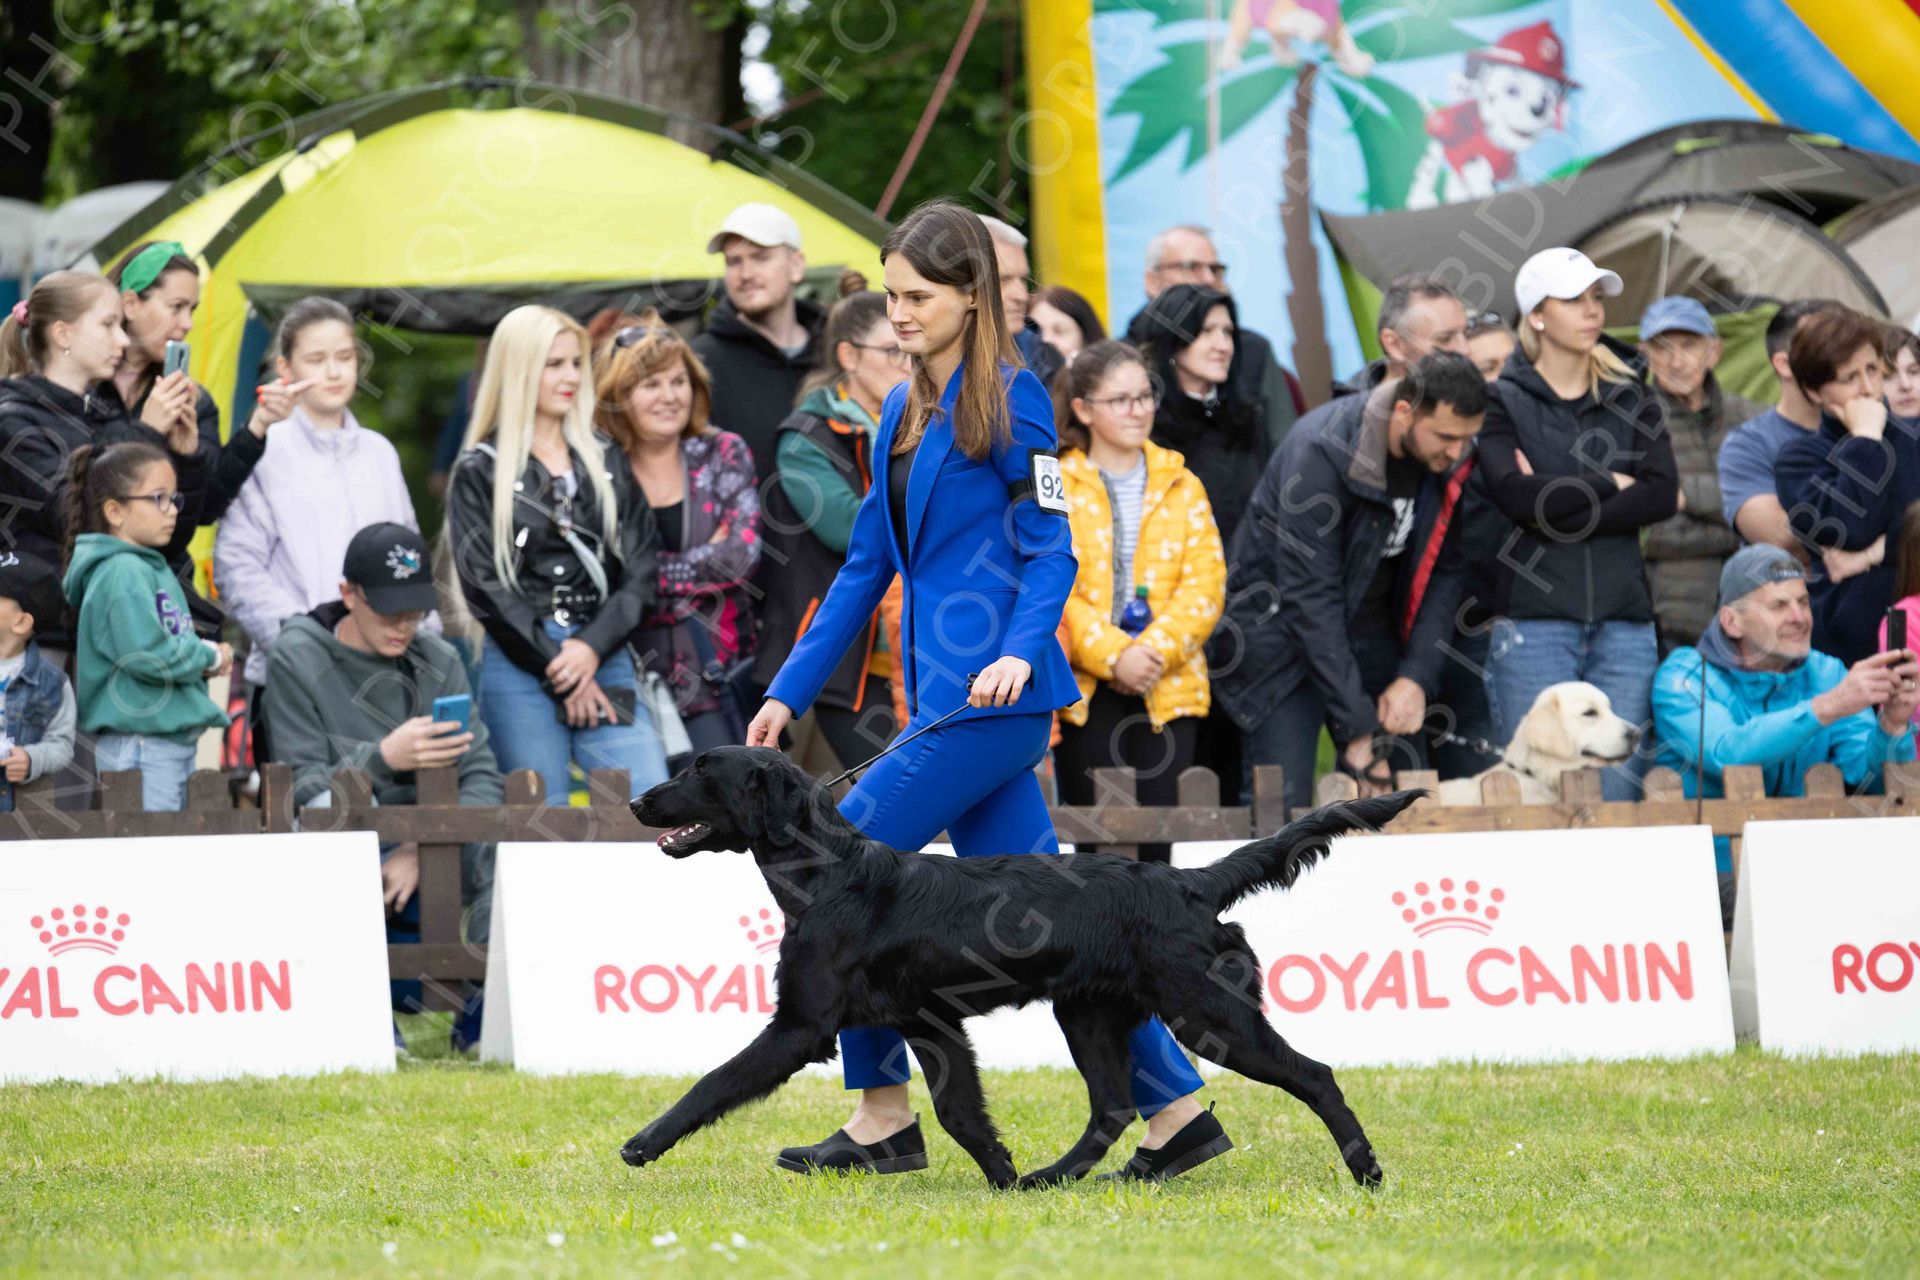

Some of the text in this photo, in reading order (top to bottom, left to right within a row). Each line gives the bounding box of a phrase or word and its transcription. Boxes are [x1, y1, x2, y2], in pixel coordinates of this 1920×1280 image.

[1041, 474, 1065, 500] 92
[93, 959, 292, 1016] CANIN
[594, 964, 777, 1014] ROYAL
[1263, 941, 1694, 1014] OYAL CANIN
